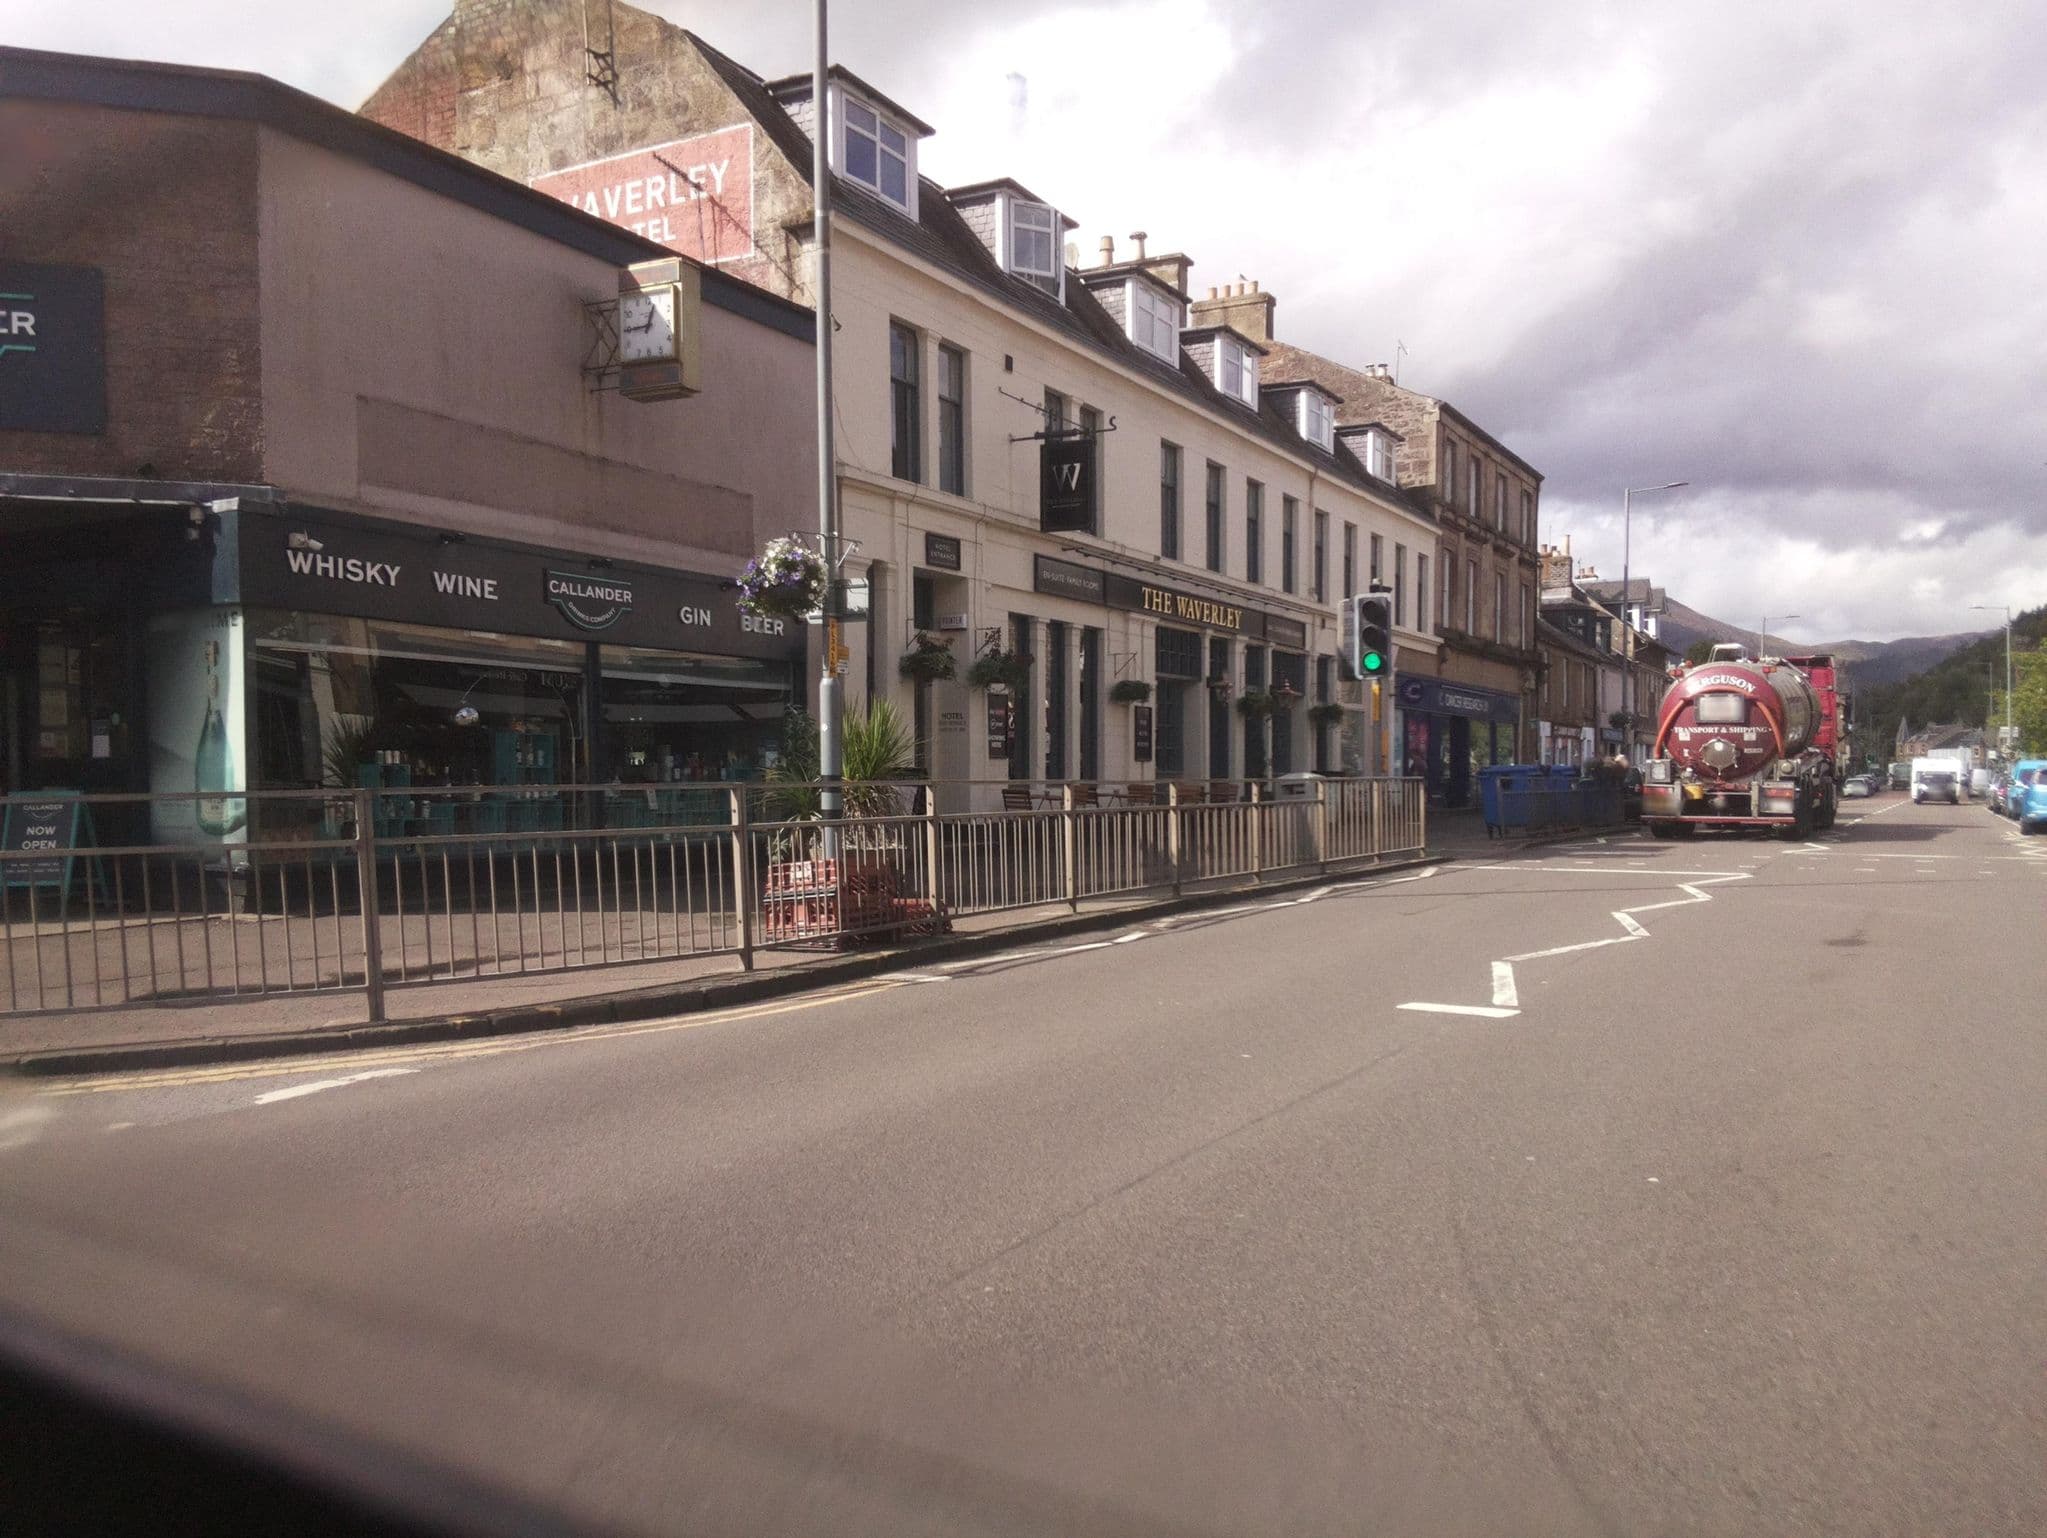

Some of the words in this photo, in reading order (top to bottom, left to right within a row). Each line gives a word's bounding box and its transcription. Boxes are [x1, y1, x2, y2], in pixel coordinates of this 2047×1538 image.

[560, 159, 729, 220] AVERLEY
[1051, 463, 1080, 493] W
[286, 549, 401, 586] WHISKY
[433, 571, 499, 600] WINE
[549, 580, 633, 604] CALLANDER
[1142, 586, 1172, 614] THE
[1176, 595, 1243, 629] WAVERLEY
[679, 606, 712, 627] GIN
[741, 615, 784, 637] BEER
[1686, 674, 1756, 695] RGUSON
[941, 712, 964, 720] HOTEL
[1674, 726, 1718, 734] TRANSPORT
[1729, 726, 1766, 734] SHIPPING
[26, 826, 56, 836] NOW
[22, 840, 57, 850] OPEN
